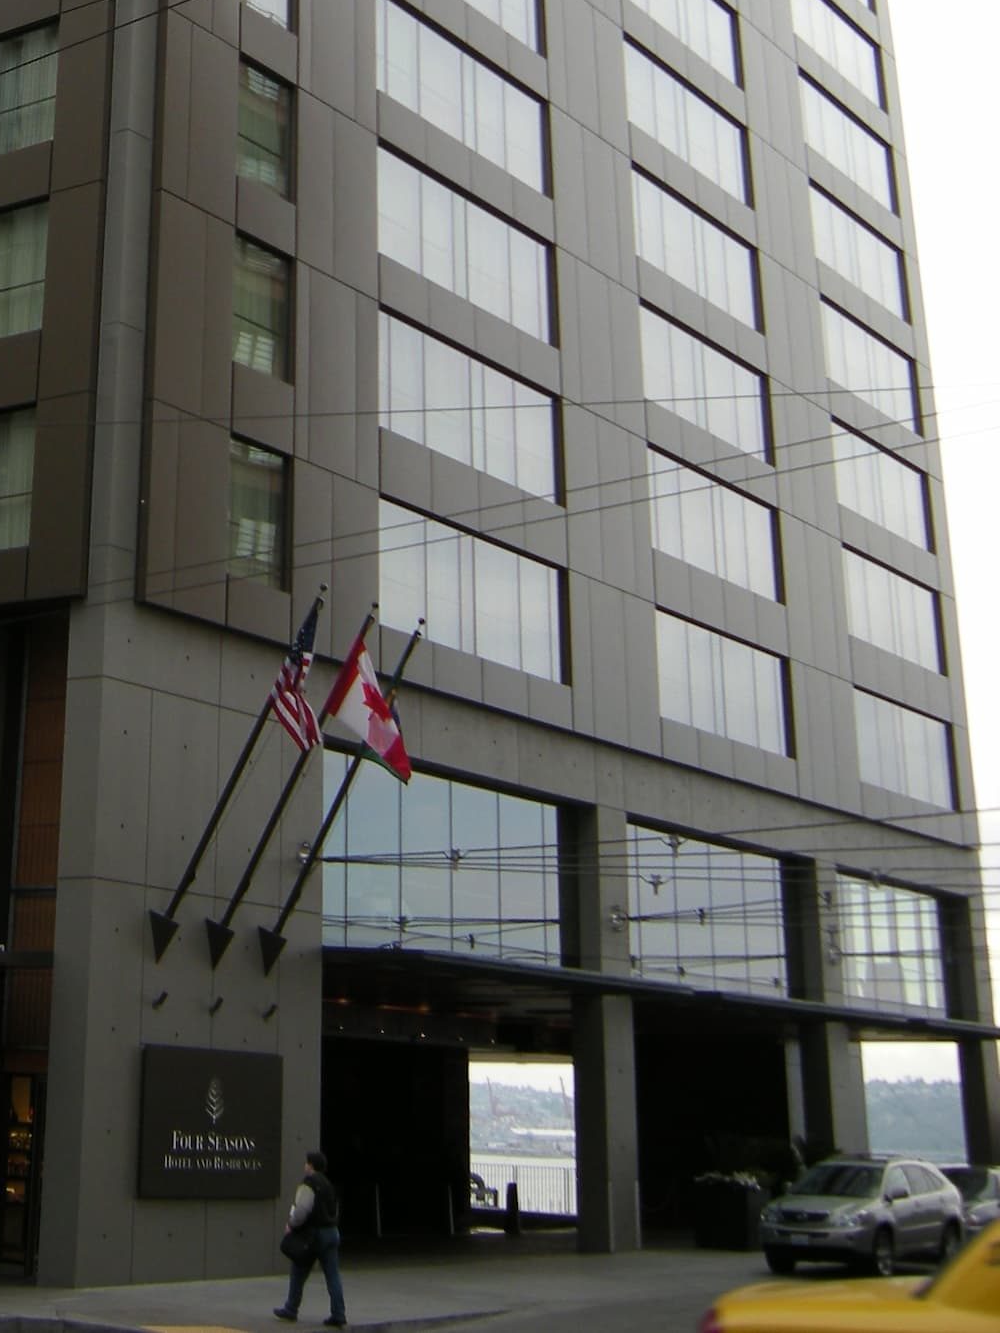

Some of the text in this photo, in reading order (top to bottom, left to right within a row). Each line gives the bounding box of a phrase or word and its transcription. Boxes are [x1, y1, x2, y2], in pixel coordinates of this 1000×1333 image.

[172, 1130, 256, 1152] FOUR SEASONS
[164, 1154, 192, 1170] HOTEL
[196, 1157, 212, 1169] AND
